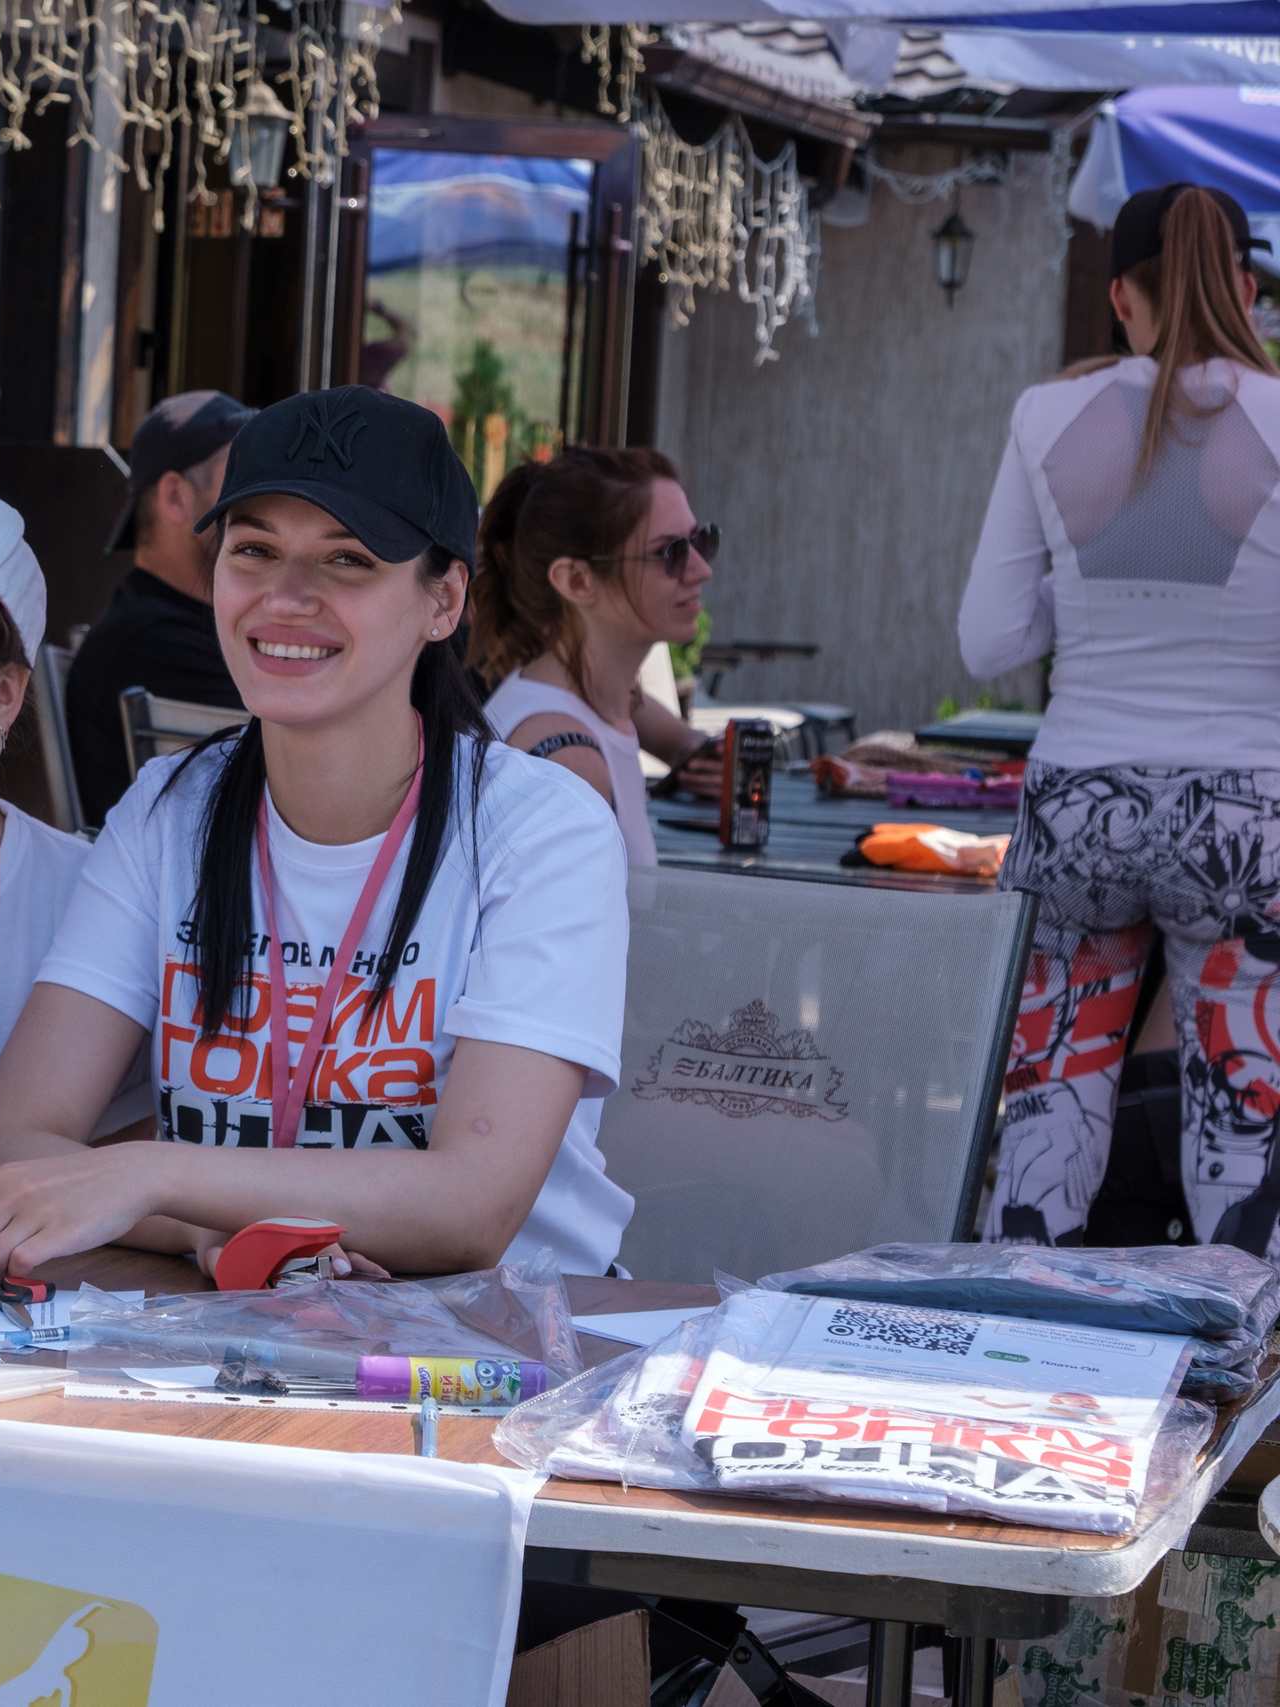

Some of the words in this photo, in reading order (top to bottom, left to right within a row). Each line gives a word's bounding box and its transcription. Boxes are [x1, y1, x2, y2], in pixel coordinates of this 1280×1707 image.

[286, 397, 368, 470] NY
[176, 920, 313, 967] ЗЕГОВ
[694, 1059, 814, 1090] БАЛТИКА
[417, 1366, 431, 1400] АНДИЯ
[439, 1375, 454, 1403] ЛЕЙ
[1080, 1365, 1101, 1373] QR
[1169, 1638, 1187, 1691] bionova
[1195, 1645, 1214, 1698] bionova
